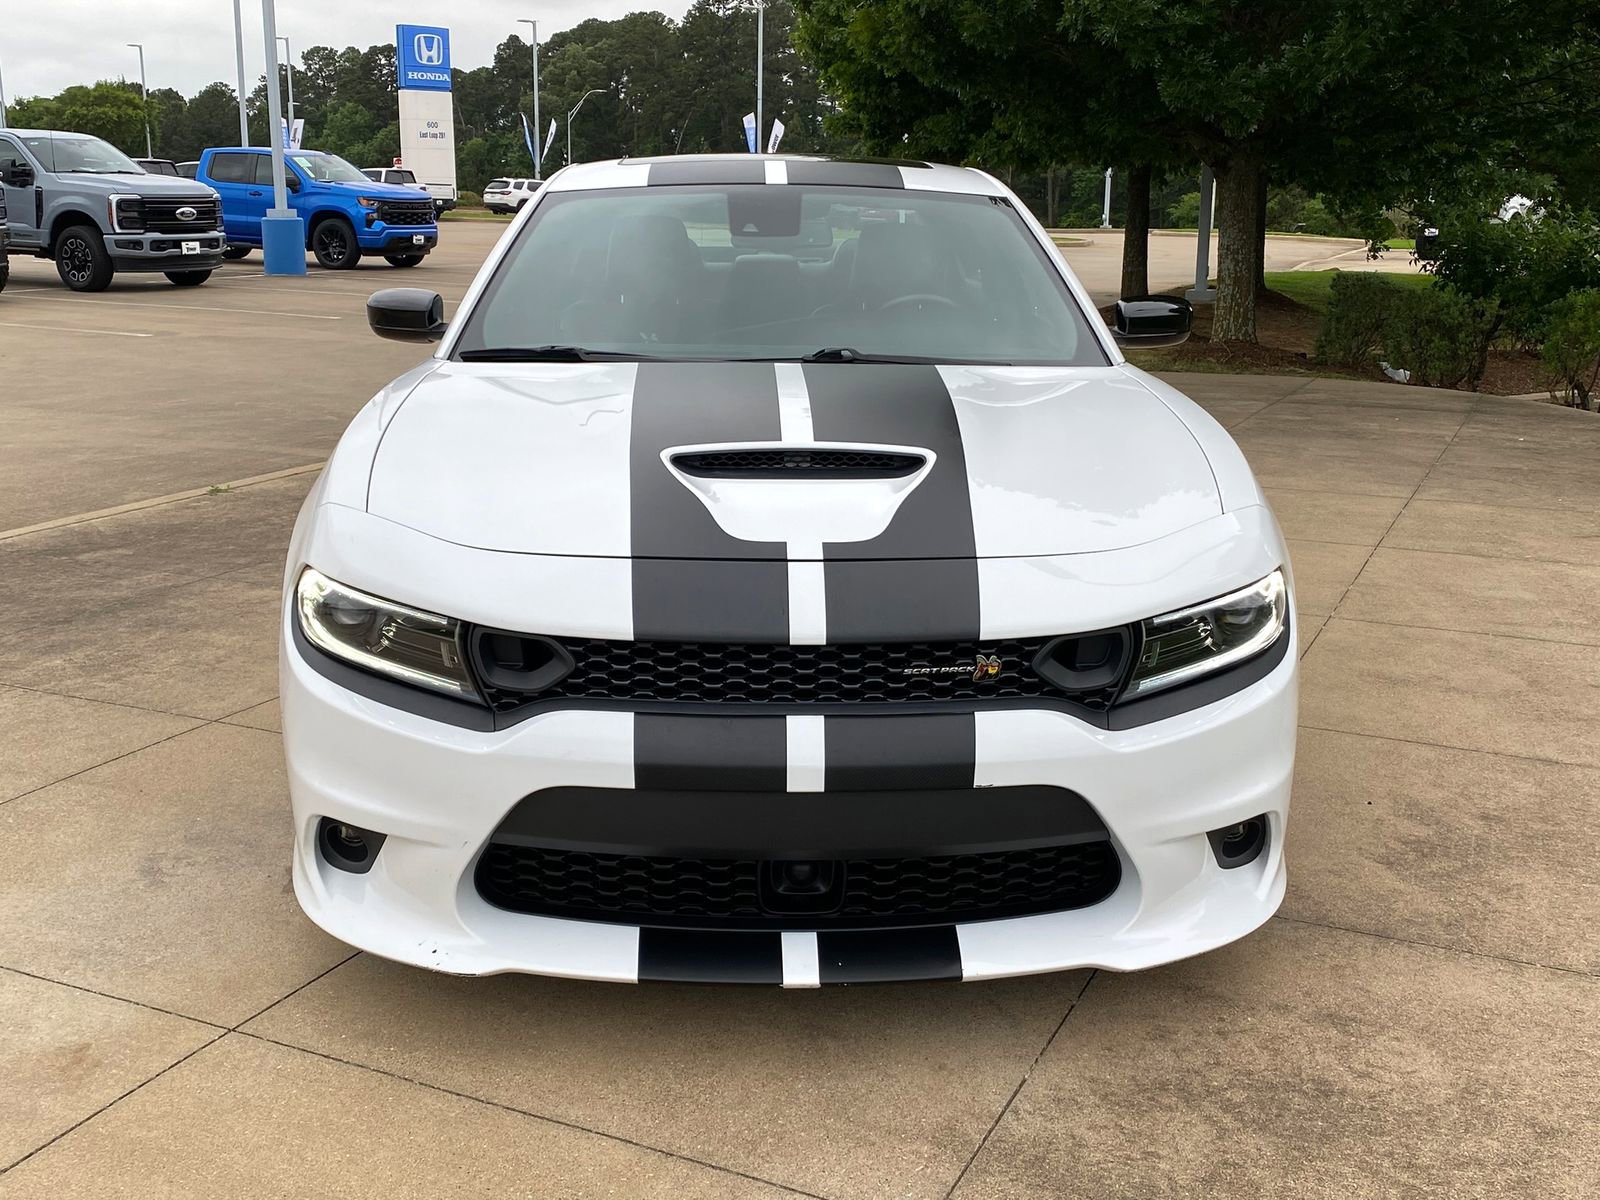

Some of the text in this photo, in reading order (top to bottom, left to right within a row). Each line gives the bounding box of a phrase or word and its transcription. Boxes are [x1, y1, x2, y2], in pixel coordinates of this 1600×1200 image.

[407, 71, 450, 81] HONDA
[426, 121, 438, 129] 600
[903, 665, 975, 675] SCAT PACK
